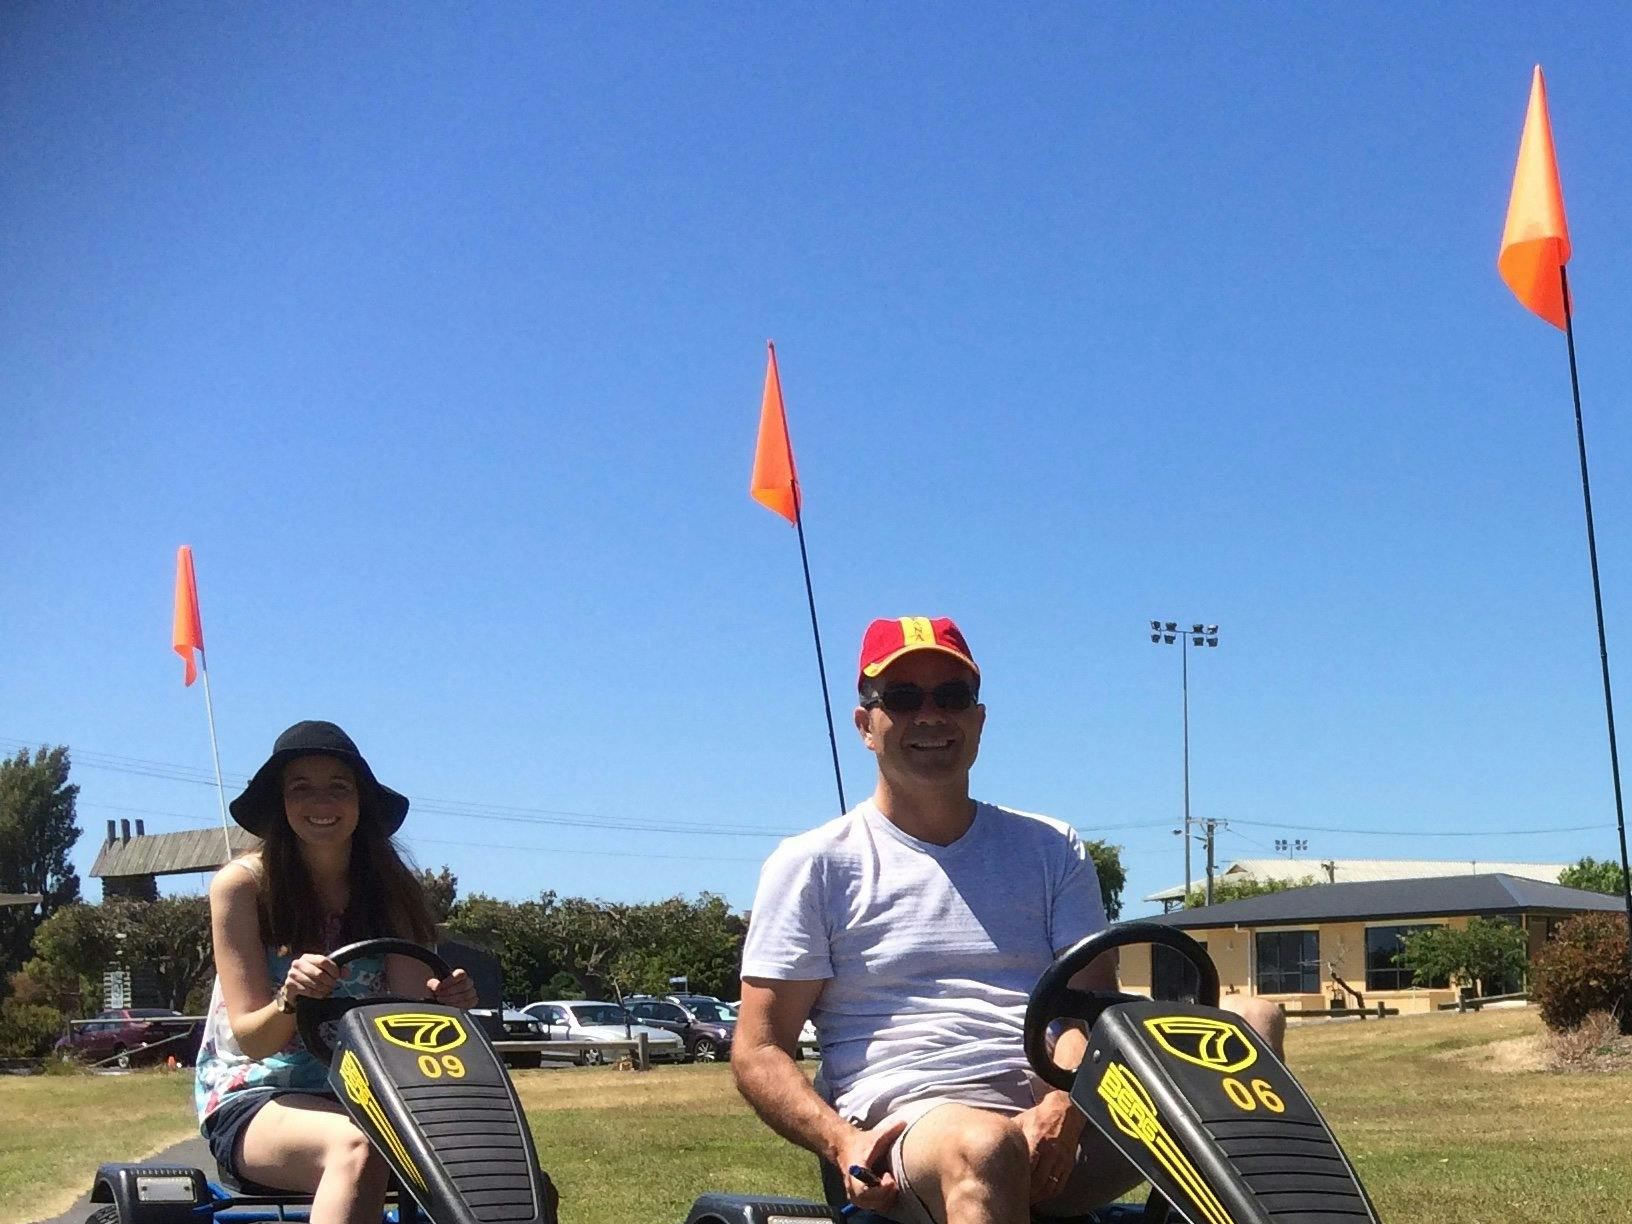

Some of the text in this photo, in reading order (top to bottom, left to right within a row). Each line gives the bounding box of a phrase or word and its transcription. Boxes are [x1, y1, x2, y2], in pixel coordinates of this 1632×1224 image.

[417, 1055, 466, 1079] 09
[1100, 1068, 1159, 1142] BERG
[1222, 1077, 1286, 1113] 06
